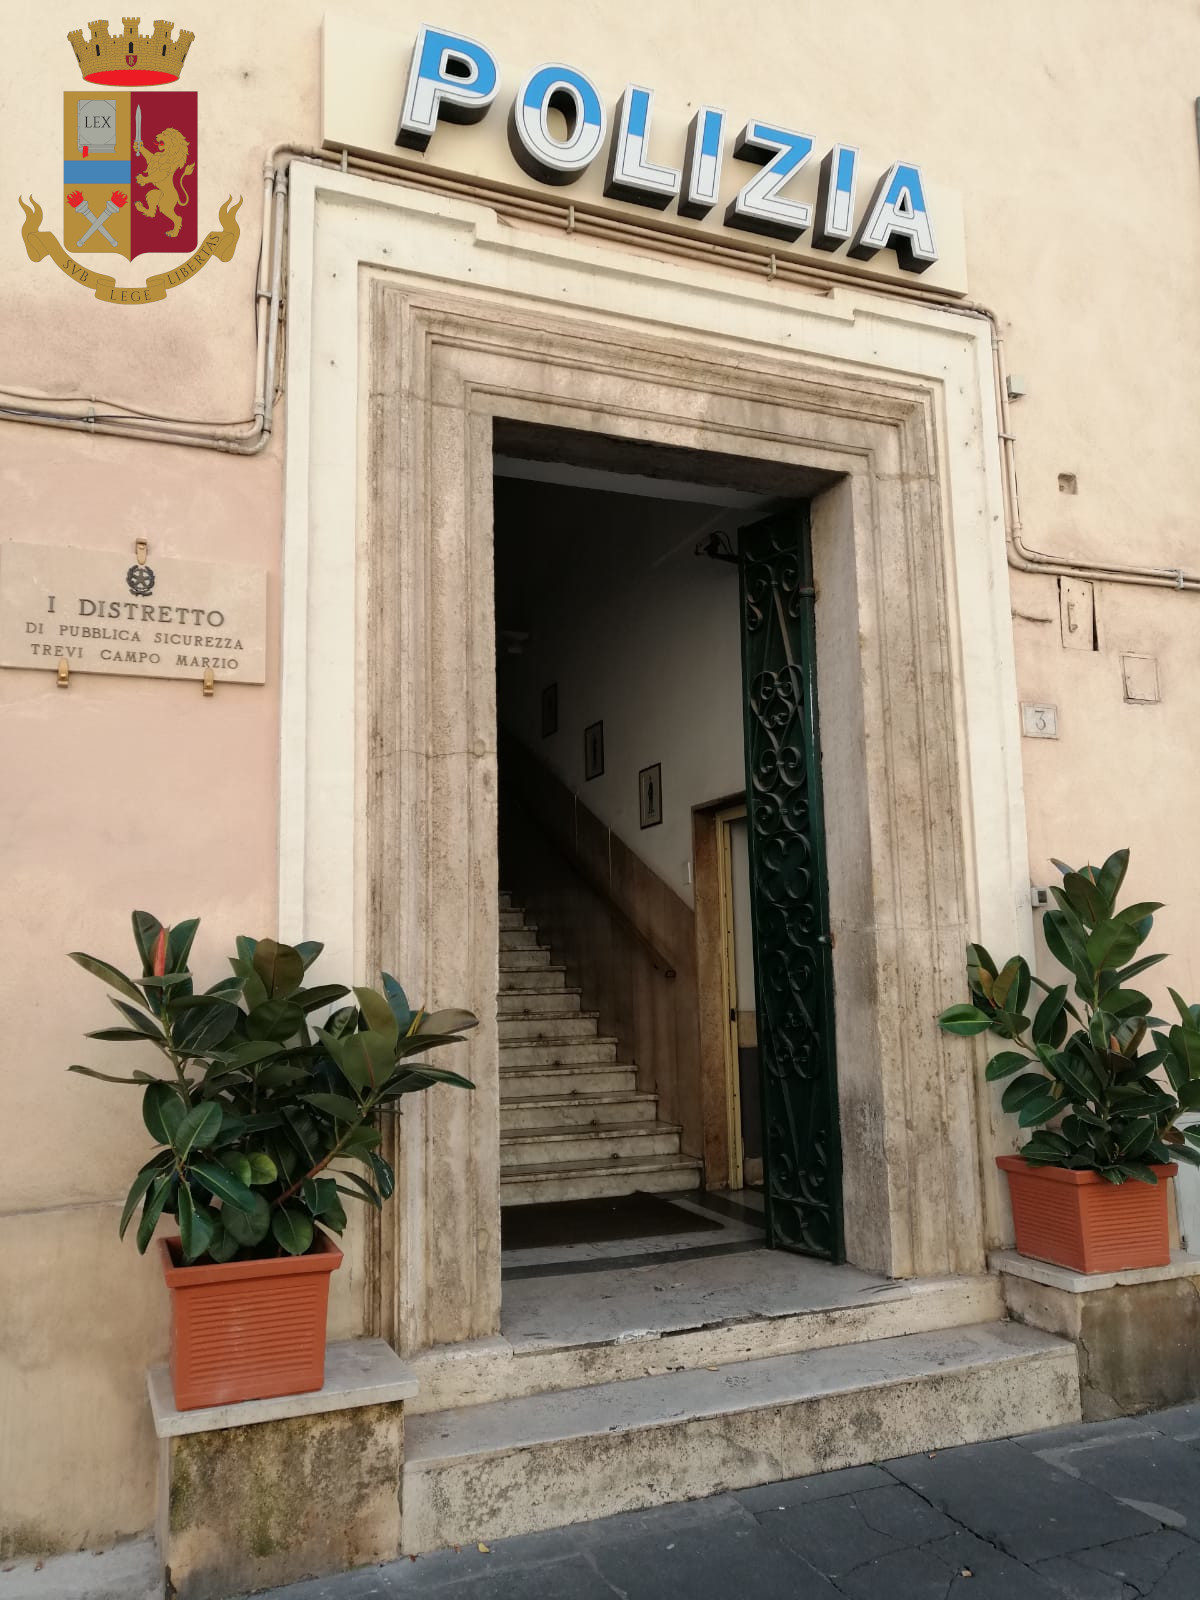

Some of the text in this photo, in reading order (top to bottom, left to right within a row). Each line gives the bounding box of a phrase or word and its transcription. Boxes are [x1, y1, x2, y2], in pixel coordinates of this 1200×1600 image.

[395, 23, 939, 274] POLIZIA
[48, 595, 225, 627] I DISTRETTO
[25, 622, 244, 650] DI PUBBLICA SICUREZZA
[31, 643, 239, 669] TREVI CAMPO MARZIO
[1034, 710, 1047, 731] 3
